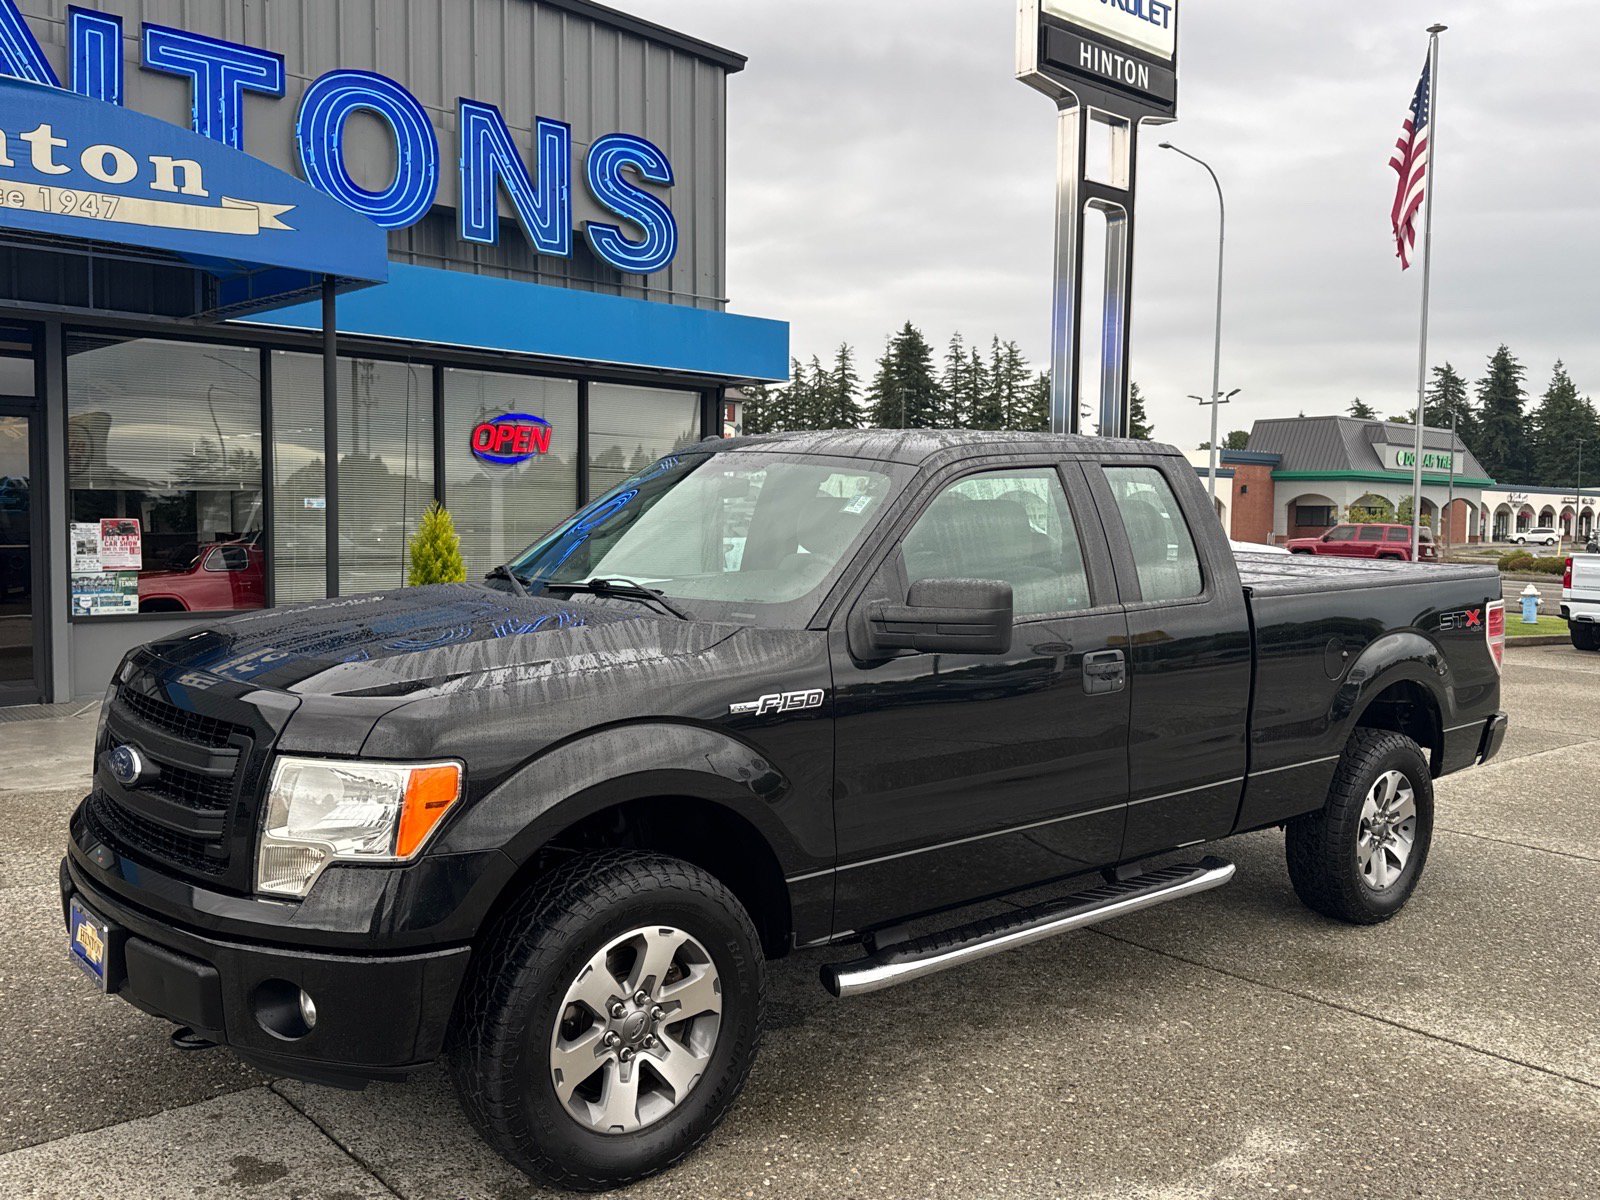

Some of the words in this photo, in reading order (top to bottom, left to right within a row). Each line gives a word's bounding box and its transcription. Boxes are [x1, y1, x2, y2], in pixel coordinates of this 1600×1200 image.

[1080, 42, 1149, 89] HINTON
[39, 187, 120, 219] 1947
[472, 423, 552, 453] OPEN
[118, 580, 138, 588] TENNIS
[1440, 609, 1480, 631] STX
[756, 688, 824, 716] F-150
